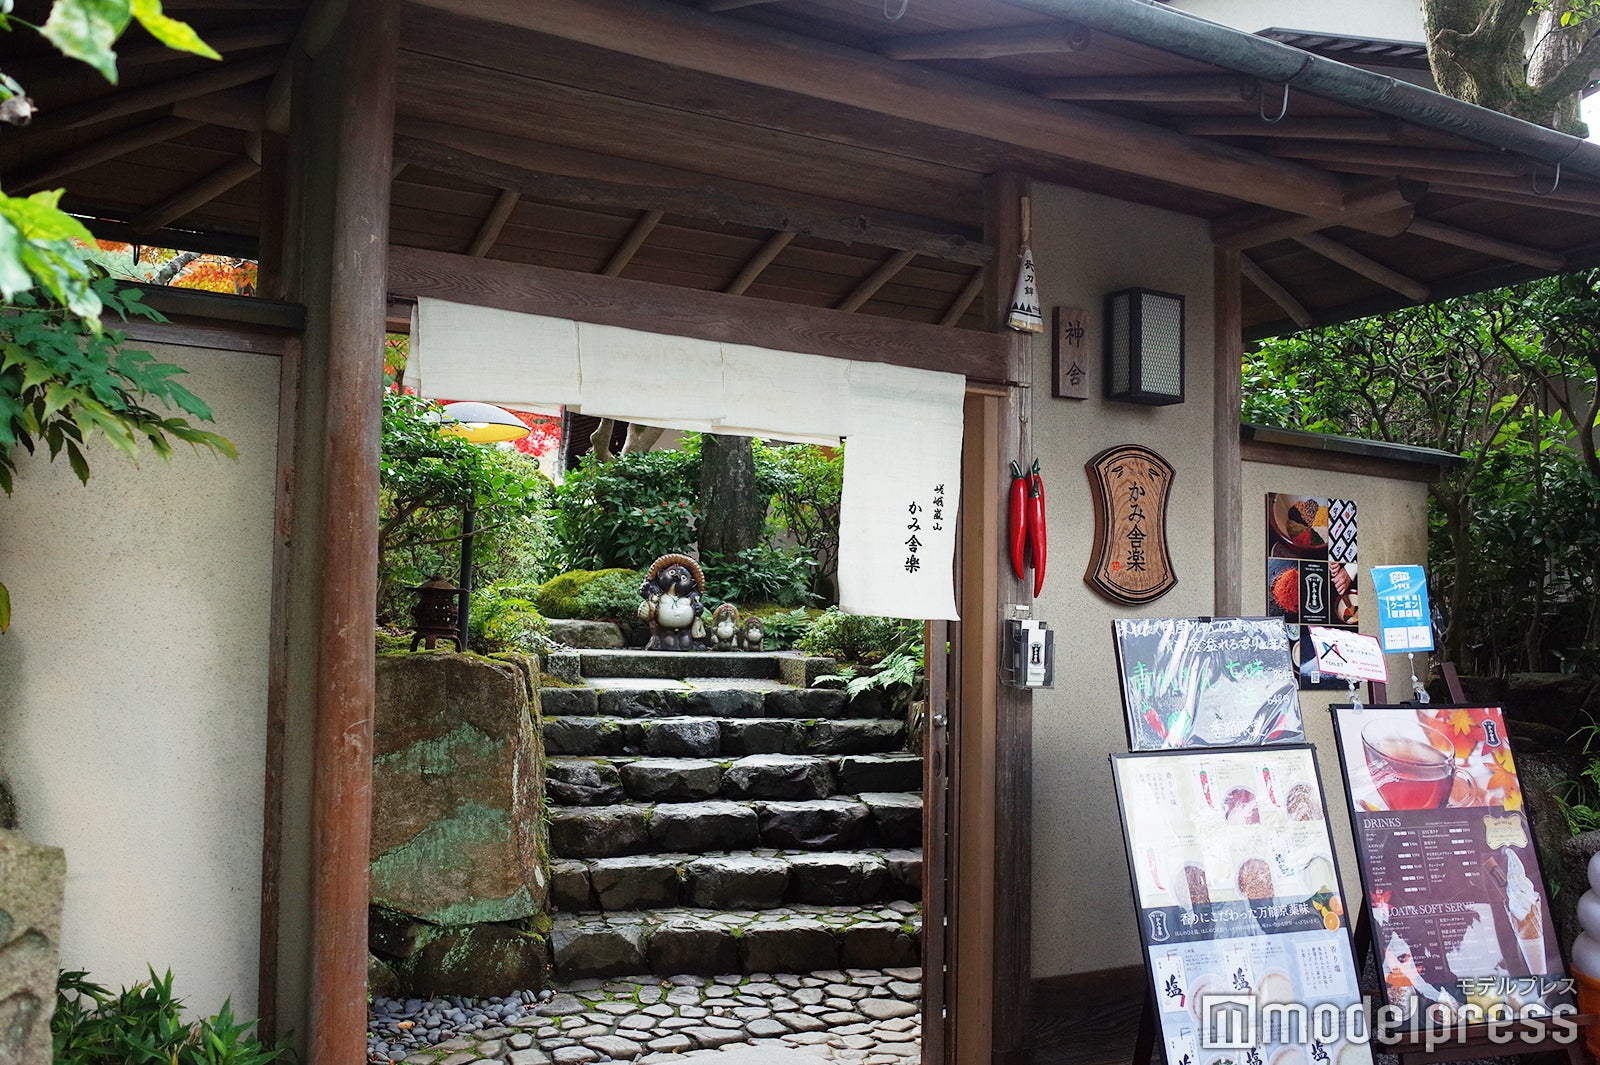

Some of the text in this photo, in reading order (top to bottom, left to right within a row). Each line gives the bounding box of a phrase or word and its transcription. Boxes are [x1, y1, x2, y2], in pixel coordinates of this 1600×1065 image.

[933, 484, 945, 531] 嵯峨嵐山
[904, 501, 922, 573] かみ舎楽
[1126, 481, 1147, 572] かみ舎楽
[1391, 601, 1419, 610] クーポン
[1225, 658, 1268, 680] 七味
[1363, 818, 1402, 829] DRINKS
[1165, 974, 1185, 998] 塩
[1311, 1038, 1329, 1062] 塩
